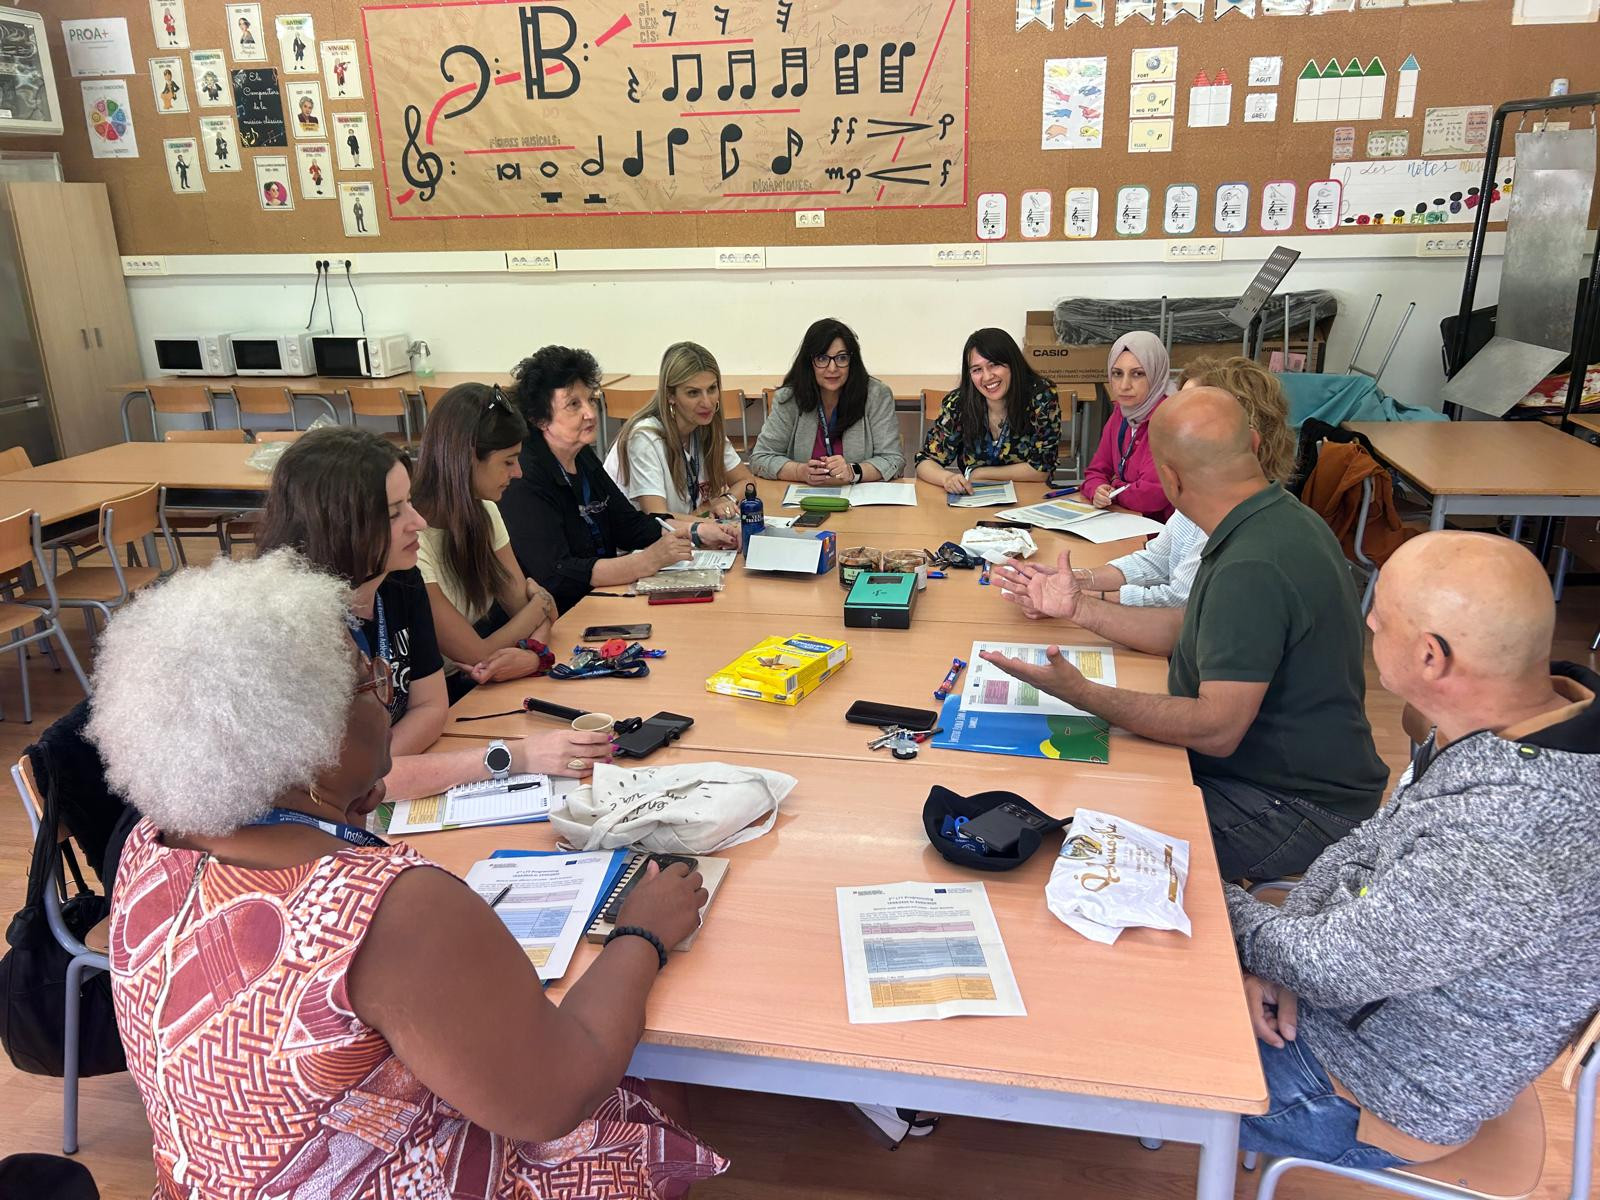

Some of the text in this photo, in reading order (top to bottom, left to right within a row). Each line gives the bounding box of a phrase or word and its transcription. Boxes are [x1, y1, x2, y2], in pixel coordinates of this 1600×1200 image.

[69, 27, 109, 41] PROA+
[1407, 161, 1456, 177] notes
[1410, 213, 1424, 224] FA
[1033, 349, 1069, 357] CASIO
[343, 827, 368, 846] Institut
